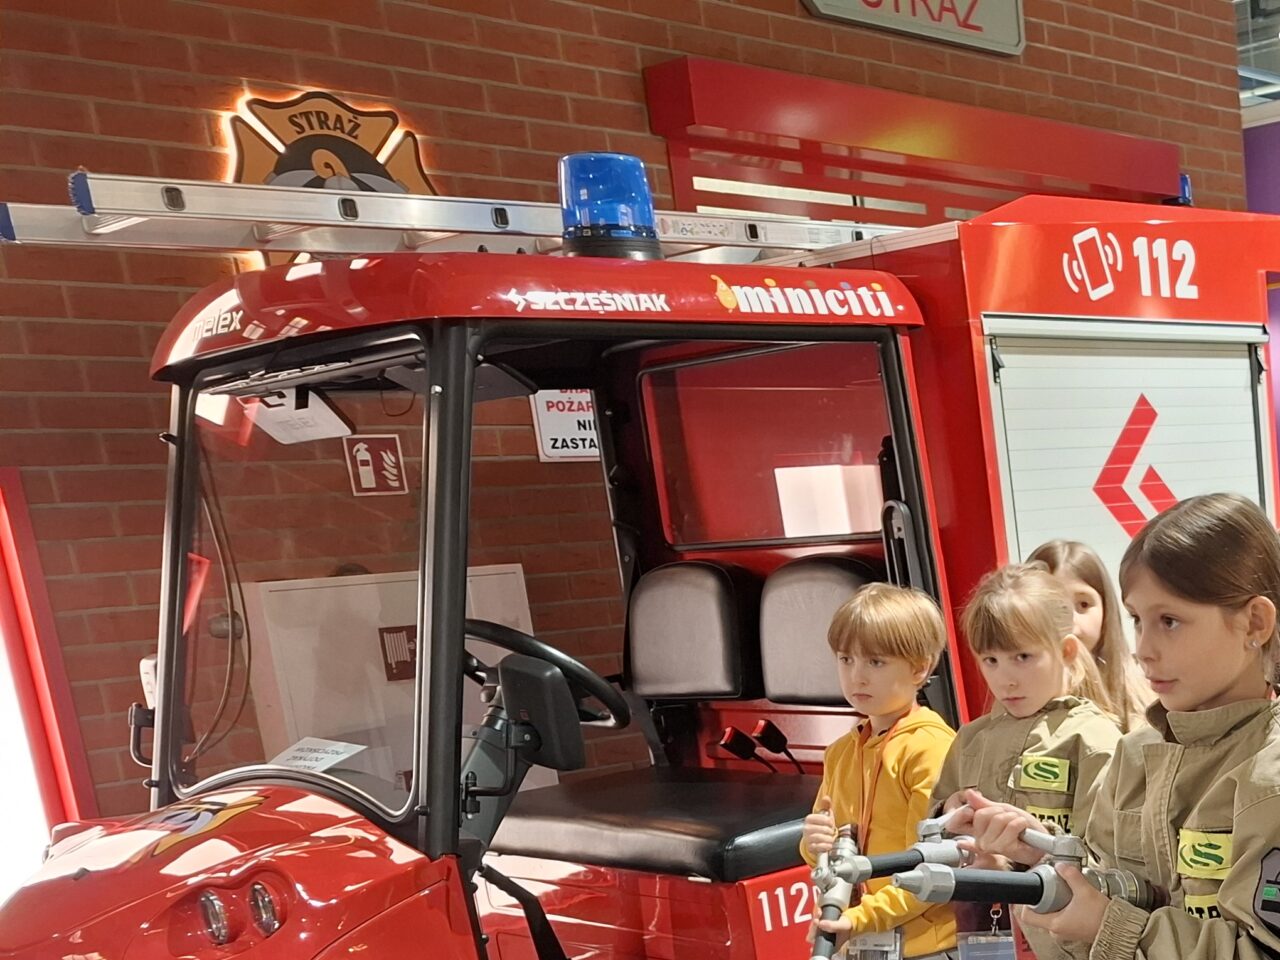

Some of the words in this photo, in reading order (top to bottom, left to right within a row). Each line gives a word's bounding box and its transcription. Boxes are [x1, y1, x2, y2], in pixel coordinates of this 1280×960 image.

[288, 110, 361, 139] STRAŻ
[1133, 236, 1199, 299] 112
[526, 289, 671, 314] SZCZĘŚNIAK
[730, 277, 896, 317] miniciti
[550, 437, 599, 449] ZASTA
[757, 881, 813, 932] 112
